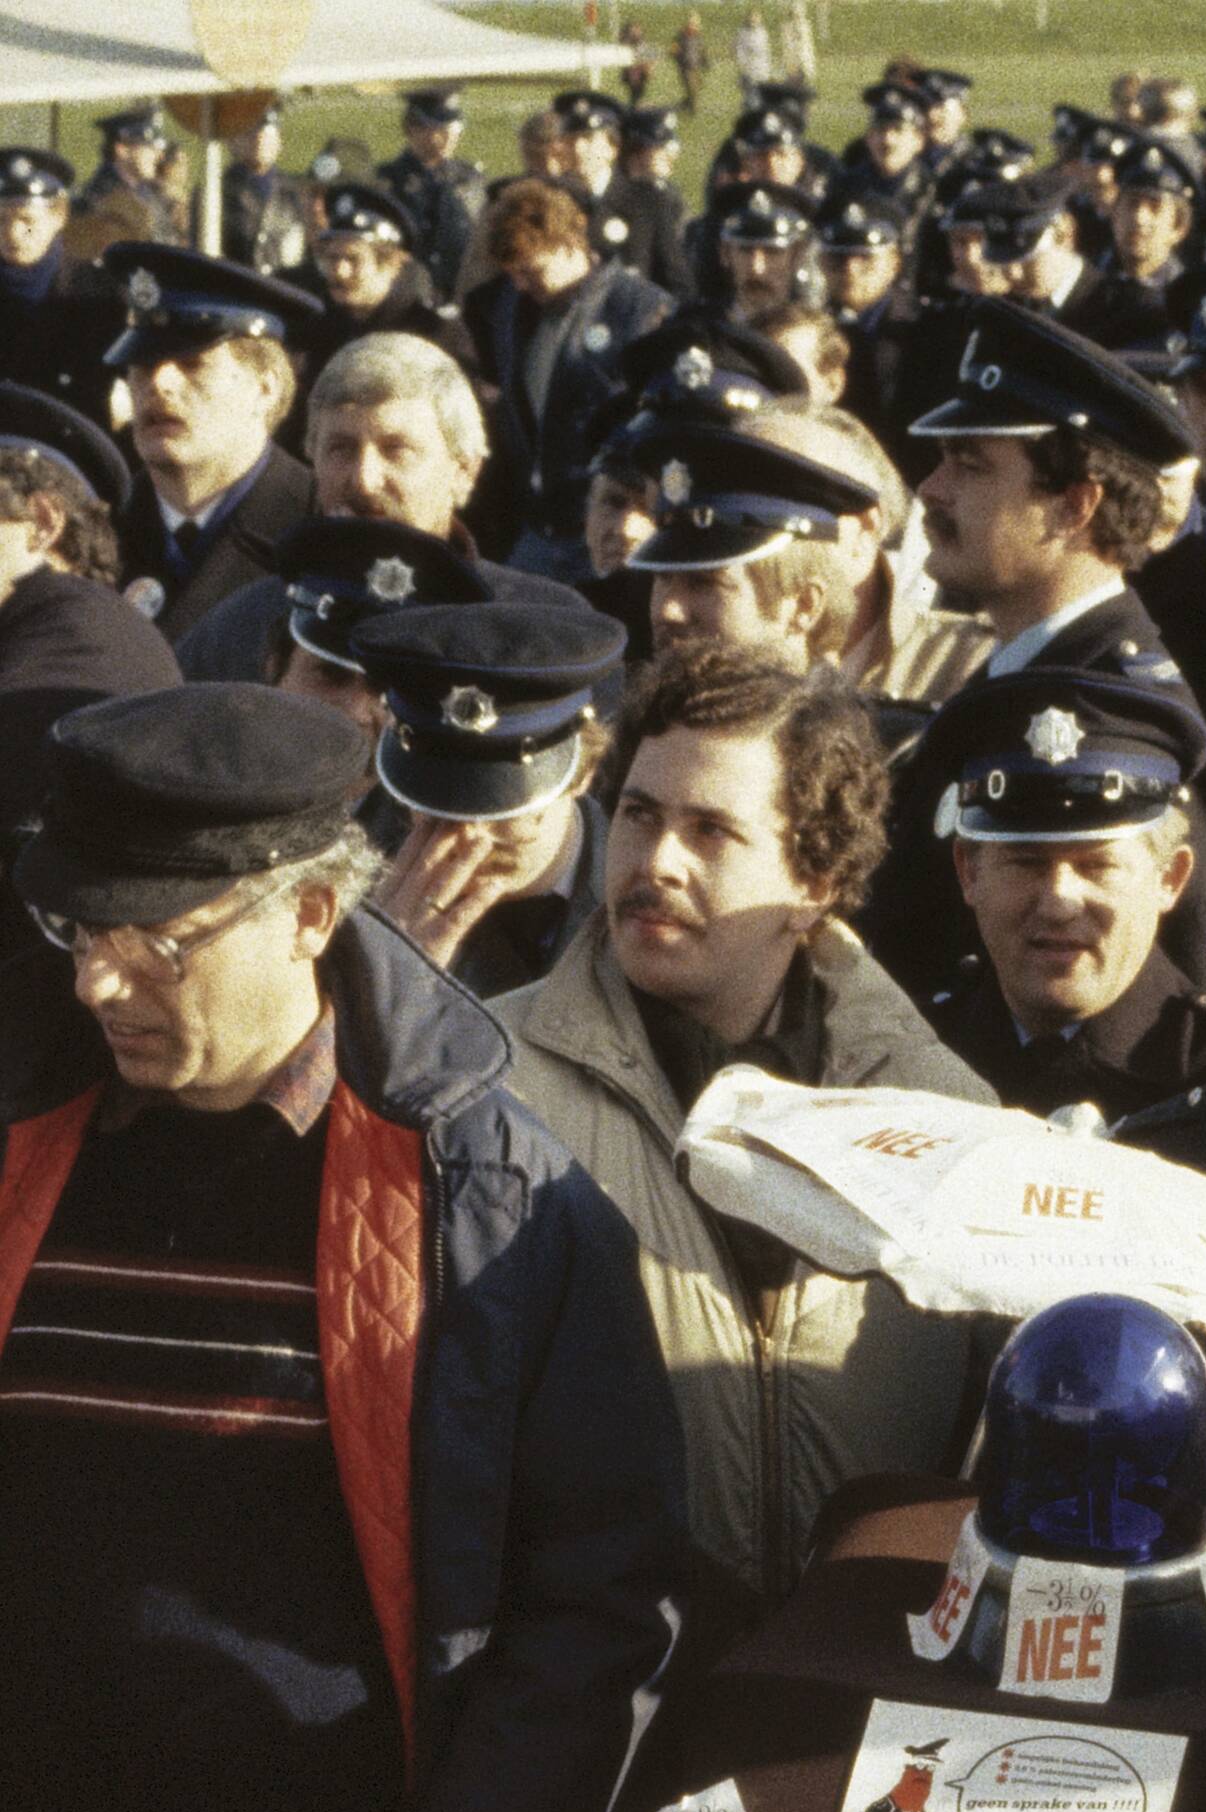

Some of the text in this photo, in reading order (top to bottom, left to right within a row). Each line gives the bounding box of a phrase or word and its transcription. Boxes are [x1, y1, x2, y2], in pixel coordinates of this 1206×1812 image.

[1022, 1182, 1105, 1221] NEE
[929, 1575, 970, 1643] EE
[1016, 1613, 1108, 1684] NEE
[966, 1797, 1008, 1811] geen
[1012, 1796, 1072, 1812] sprake
[1077, 1800, 1108, 1810] van
